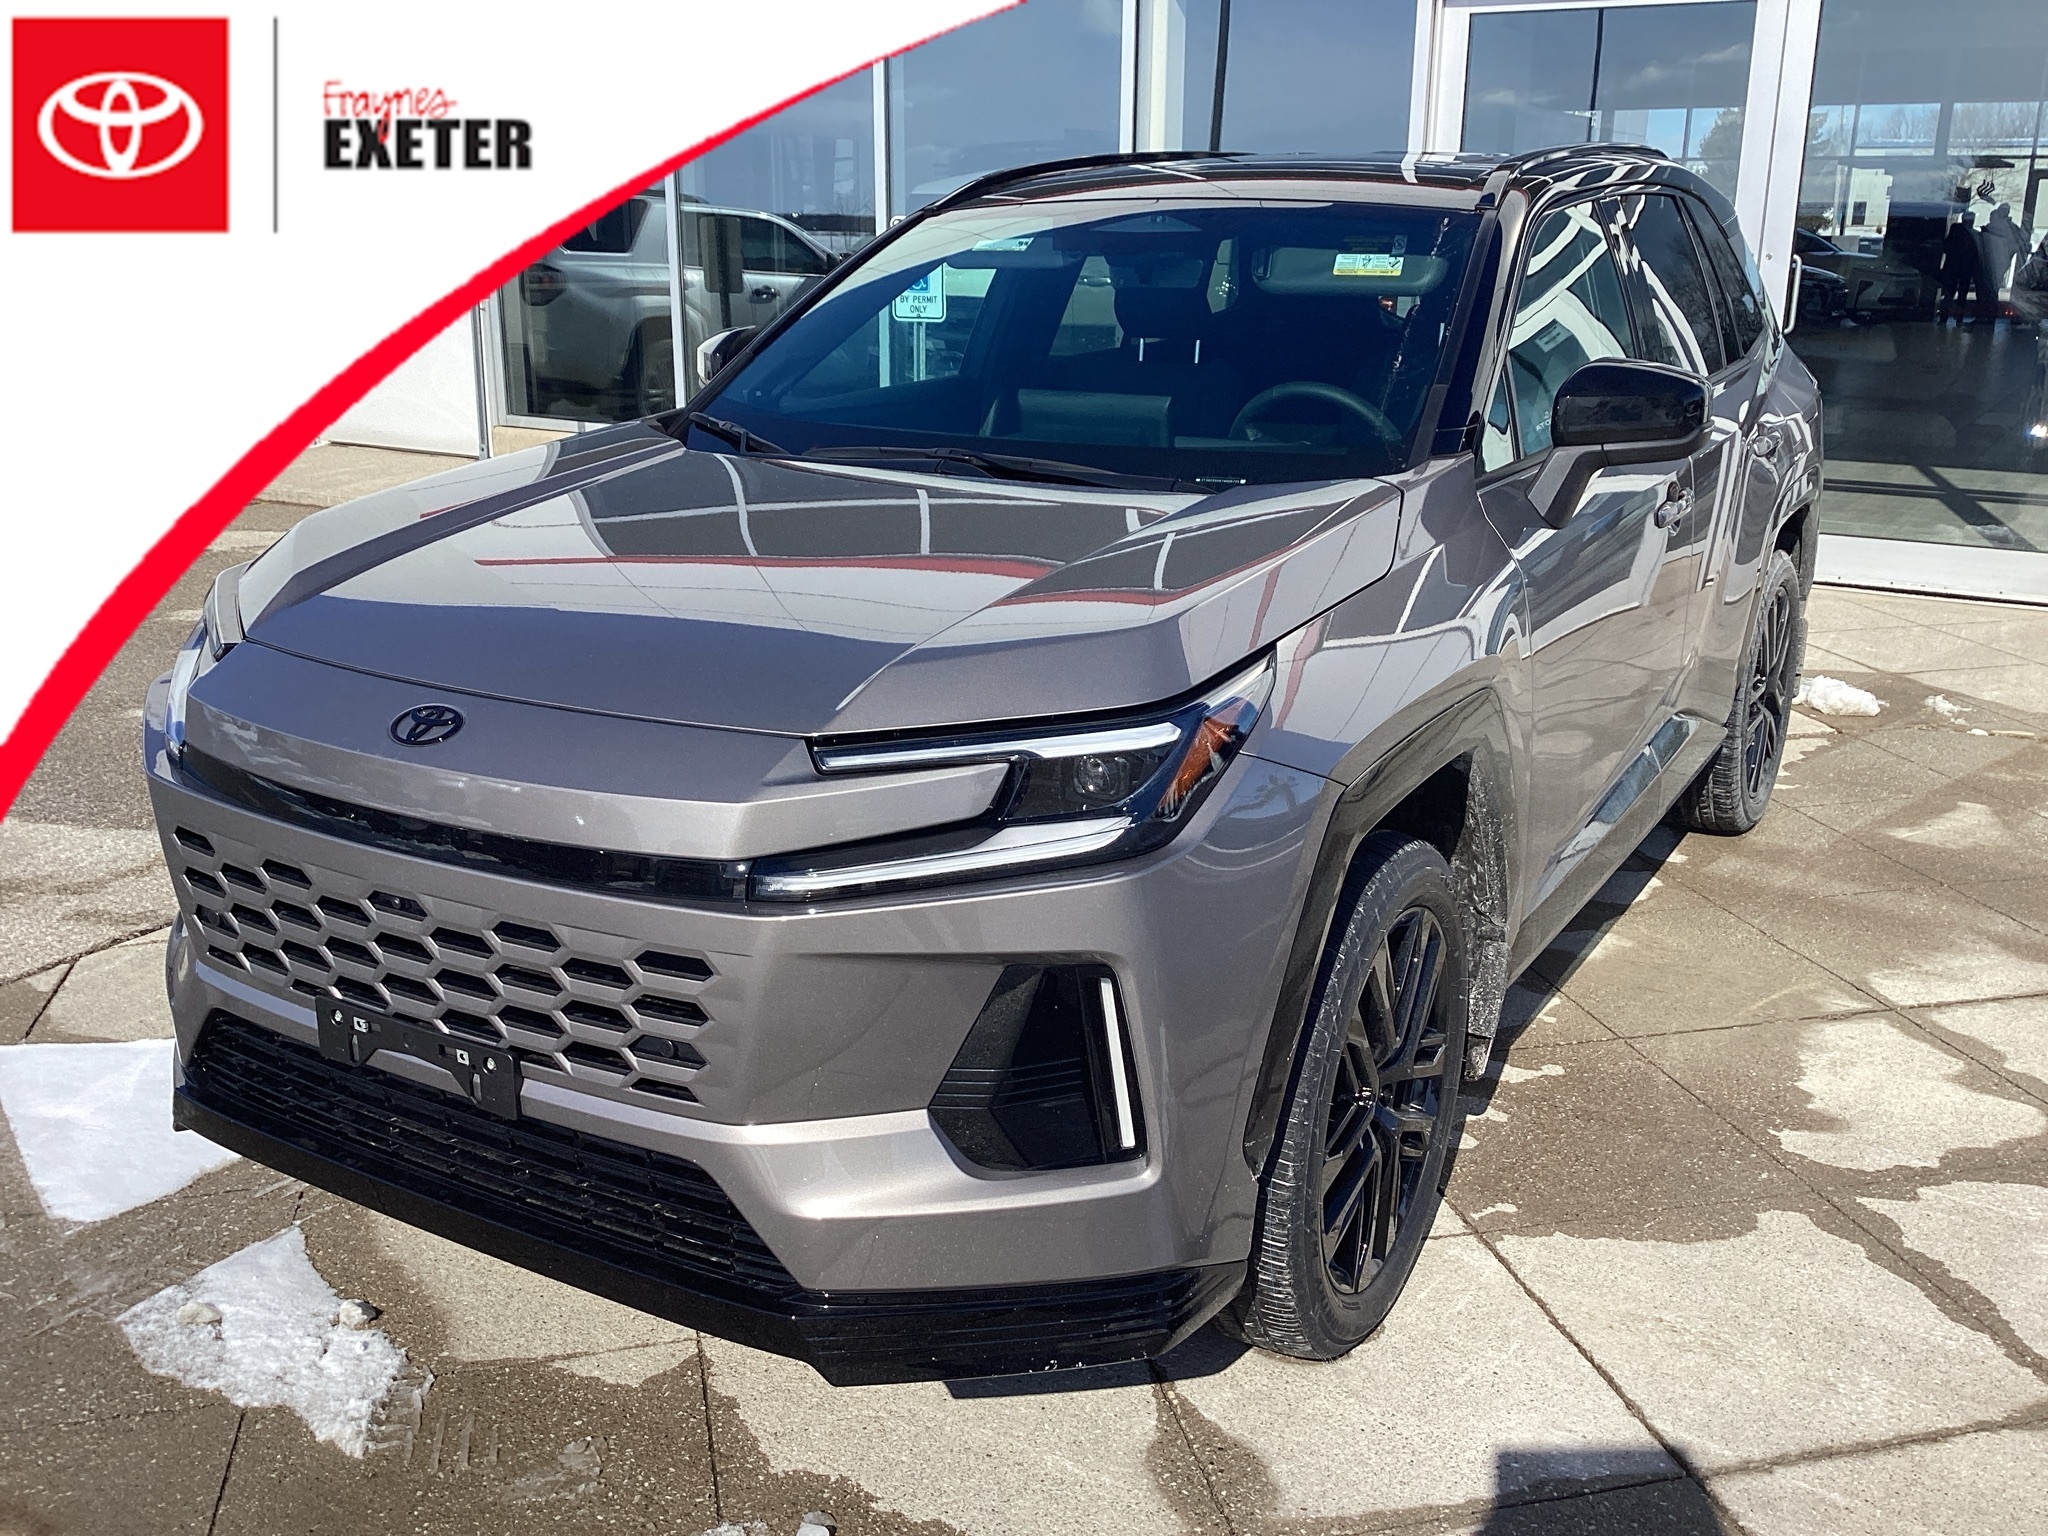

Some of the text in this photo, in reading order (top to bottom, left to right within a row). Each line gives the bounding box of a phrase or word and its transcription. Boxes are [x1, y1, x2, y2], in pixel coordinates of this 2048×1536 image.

[899, 295, 938, 304] BY PERMIT
[909, 304, 927, 314] ONLY
